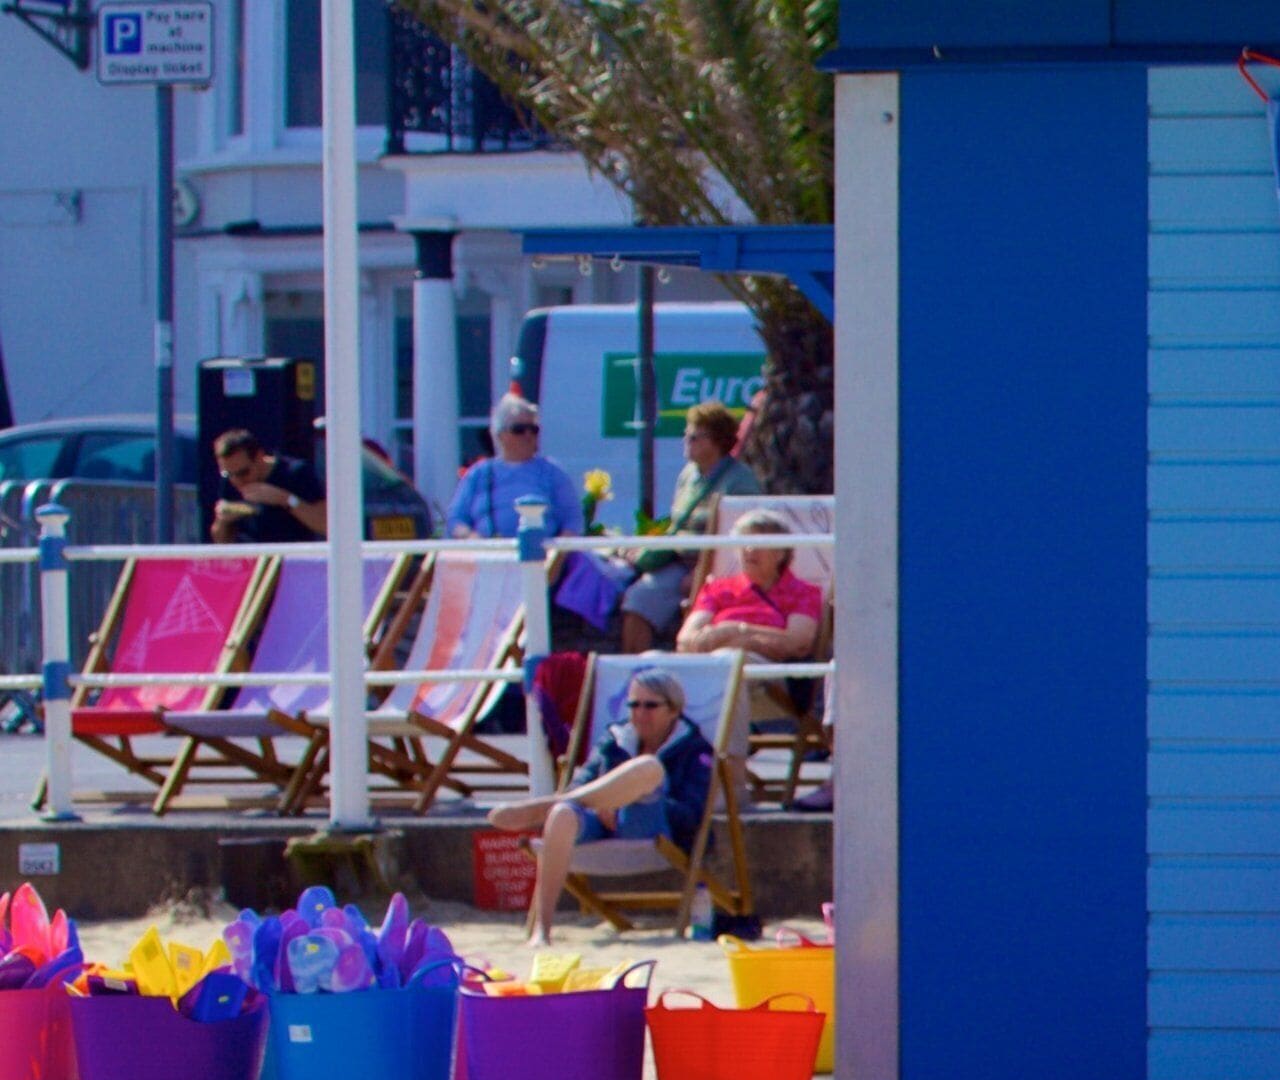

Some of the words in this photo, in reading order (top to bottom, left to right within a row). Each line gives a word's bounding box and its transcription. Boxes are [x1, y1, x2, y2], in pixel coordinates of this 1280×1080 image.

[146, 11, 170, 24] Pay
[174, 10, 205, 21] here
[112, 18, 137, 51] P
[168, 26, 183, 37] at
[146, 42, 204, 52] machine
[107, 62, 158, 75] Display
[162, 62, 203, 73] ticket
